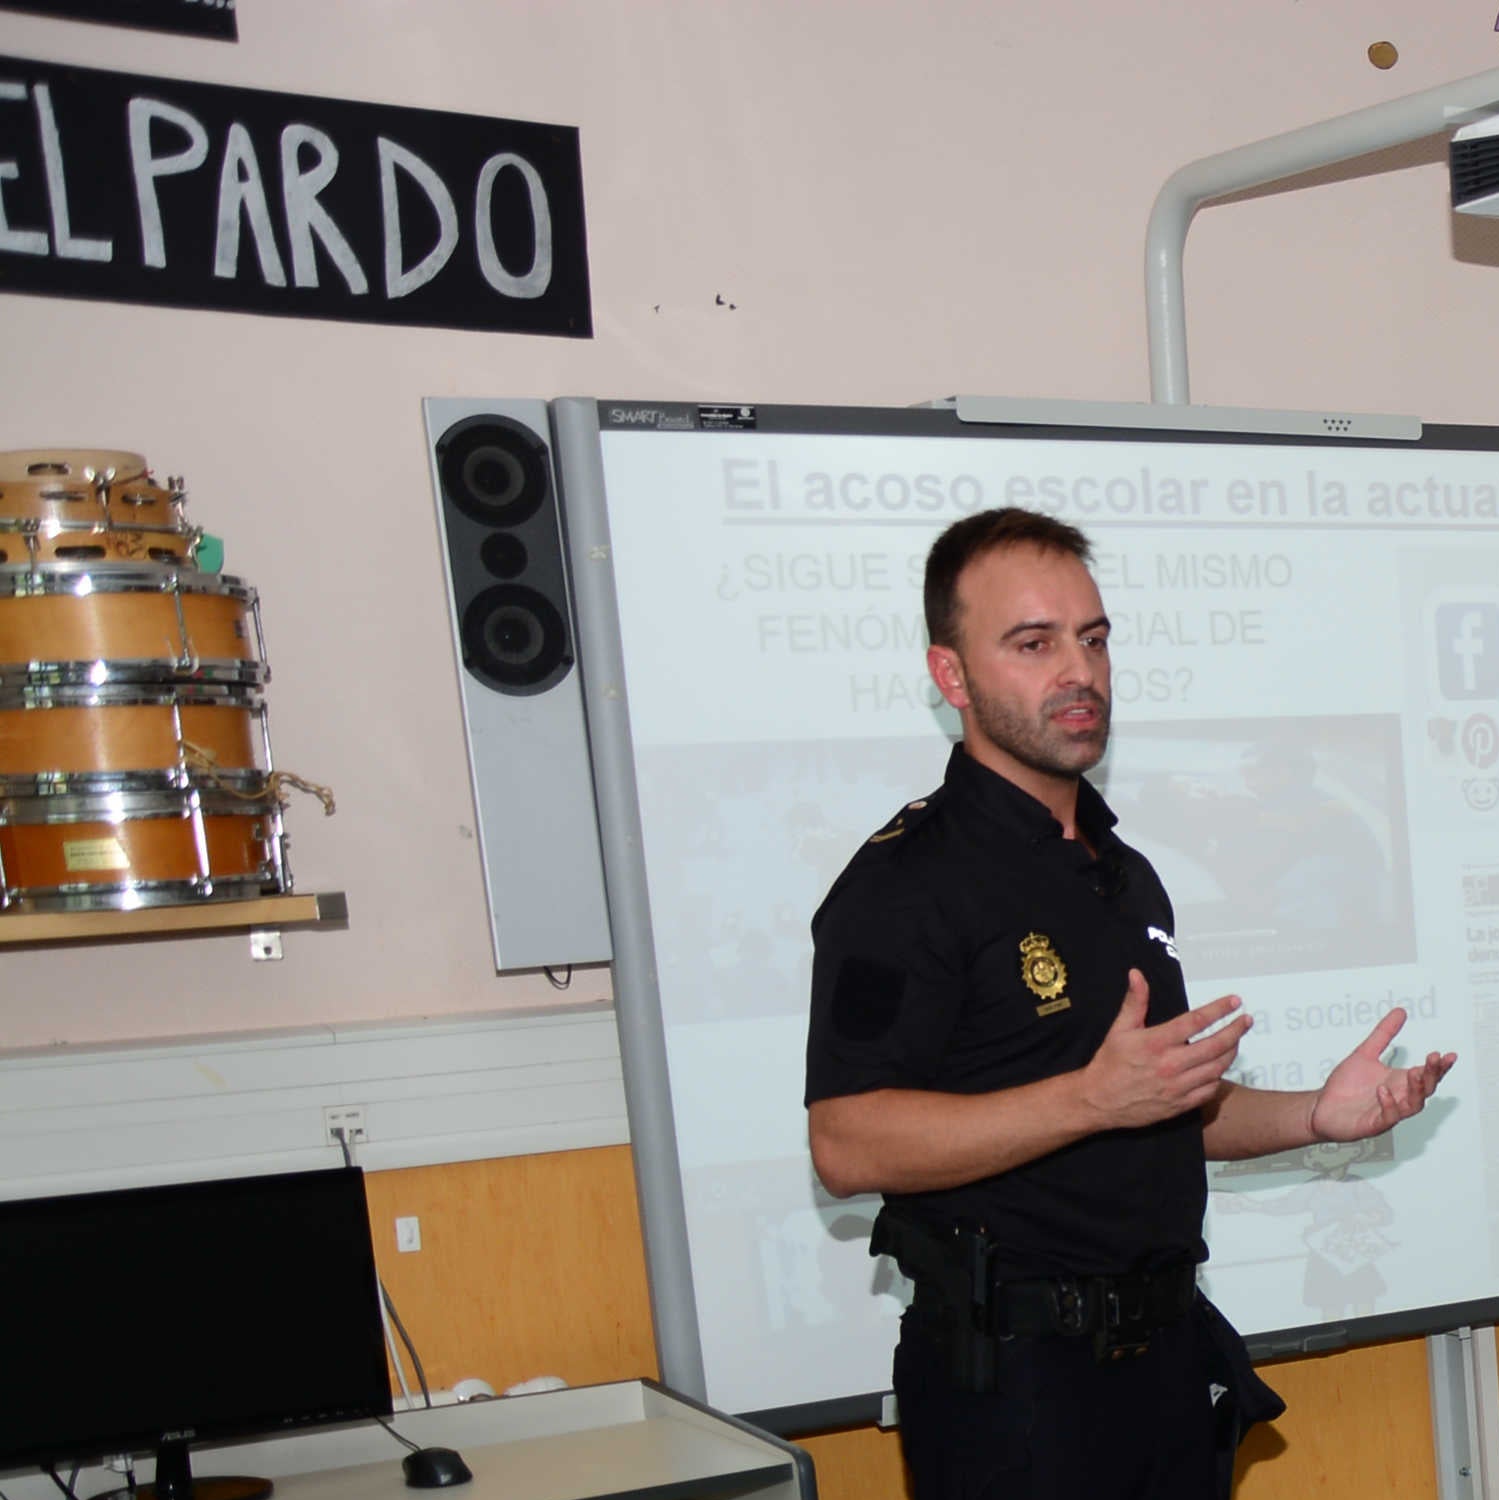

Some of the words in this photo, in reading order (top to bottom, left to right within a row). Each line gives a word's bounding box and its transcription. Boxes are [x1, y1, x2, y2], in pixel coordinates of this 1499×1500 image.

[128, 97, 552, 299] PARDO
[610, 408, 659, 424] SMART
[722, 457, 783, 512] El
[803, 472, 983, 514] acoso
[1004, 466, 1209, 516] escolar
[1226, 477, 1288, 517] en
[1306, 470, 1348, 517] la
[715, 552, 892, 602] ¿SIGUE
[1155, 553, 1294, 590] MISMO
[1208, 610, 1266, 645] DE
